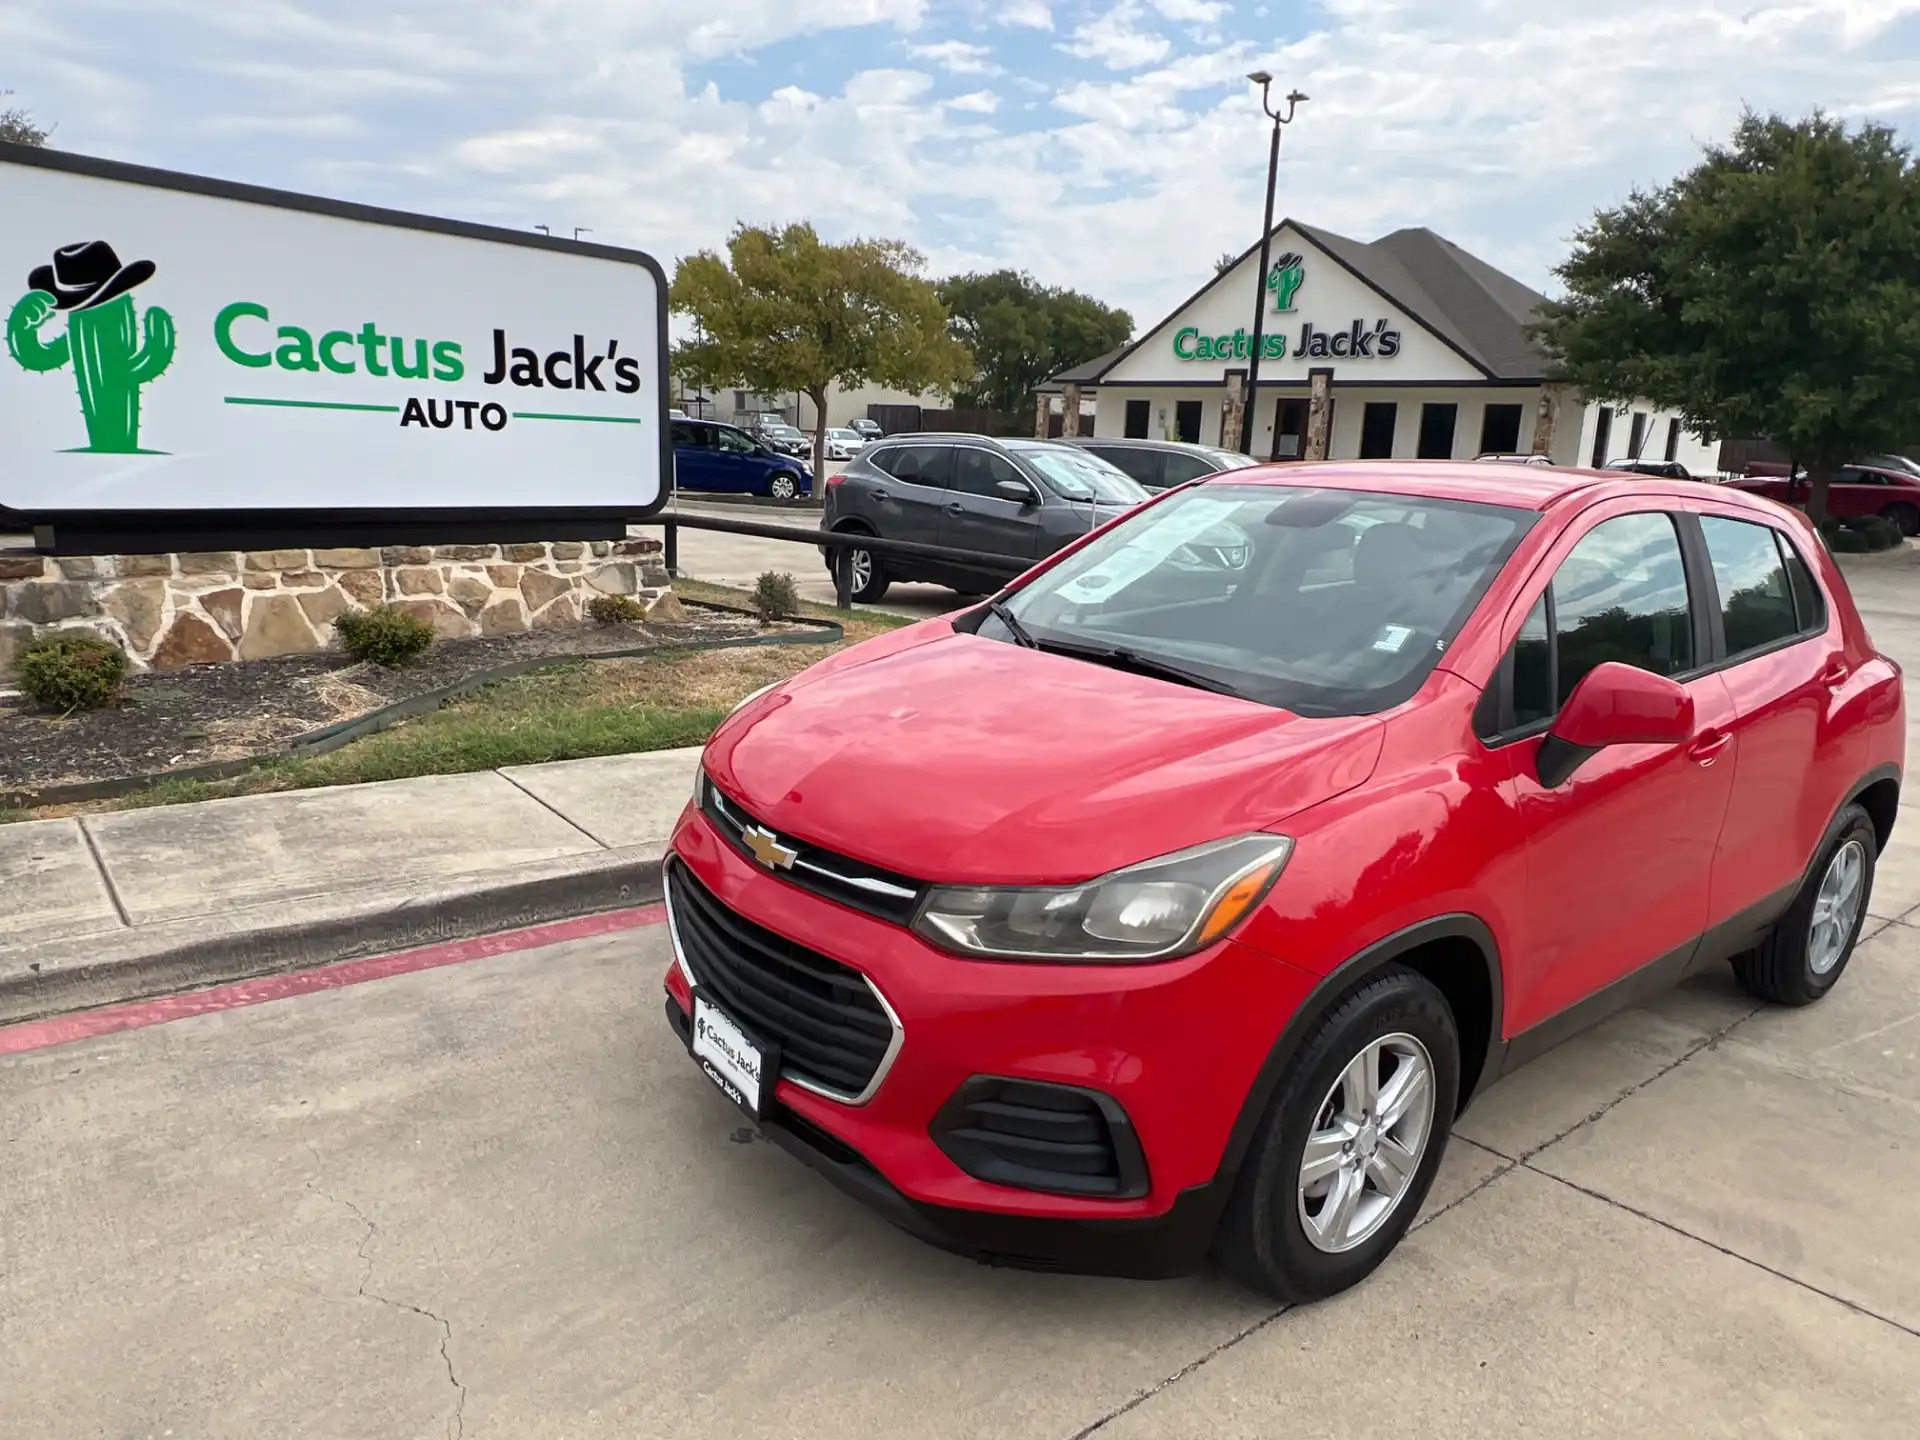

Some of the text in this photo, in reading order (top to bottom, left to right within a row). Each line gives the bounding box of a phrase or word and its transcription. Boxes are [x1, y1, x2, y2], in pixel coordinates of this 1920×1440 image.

[214, 302, 641, 394] Cactus Jack's
[1173, 318, 1401, 361] Cactus Jack's
[400, 397, 508, 431] AUTO
[703, 1060, 724, 1087] Cactus
[706, 1024, 761, 1081] Cactus Jack's
